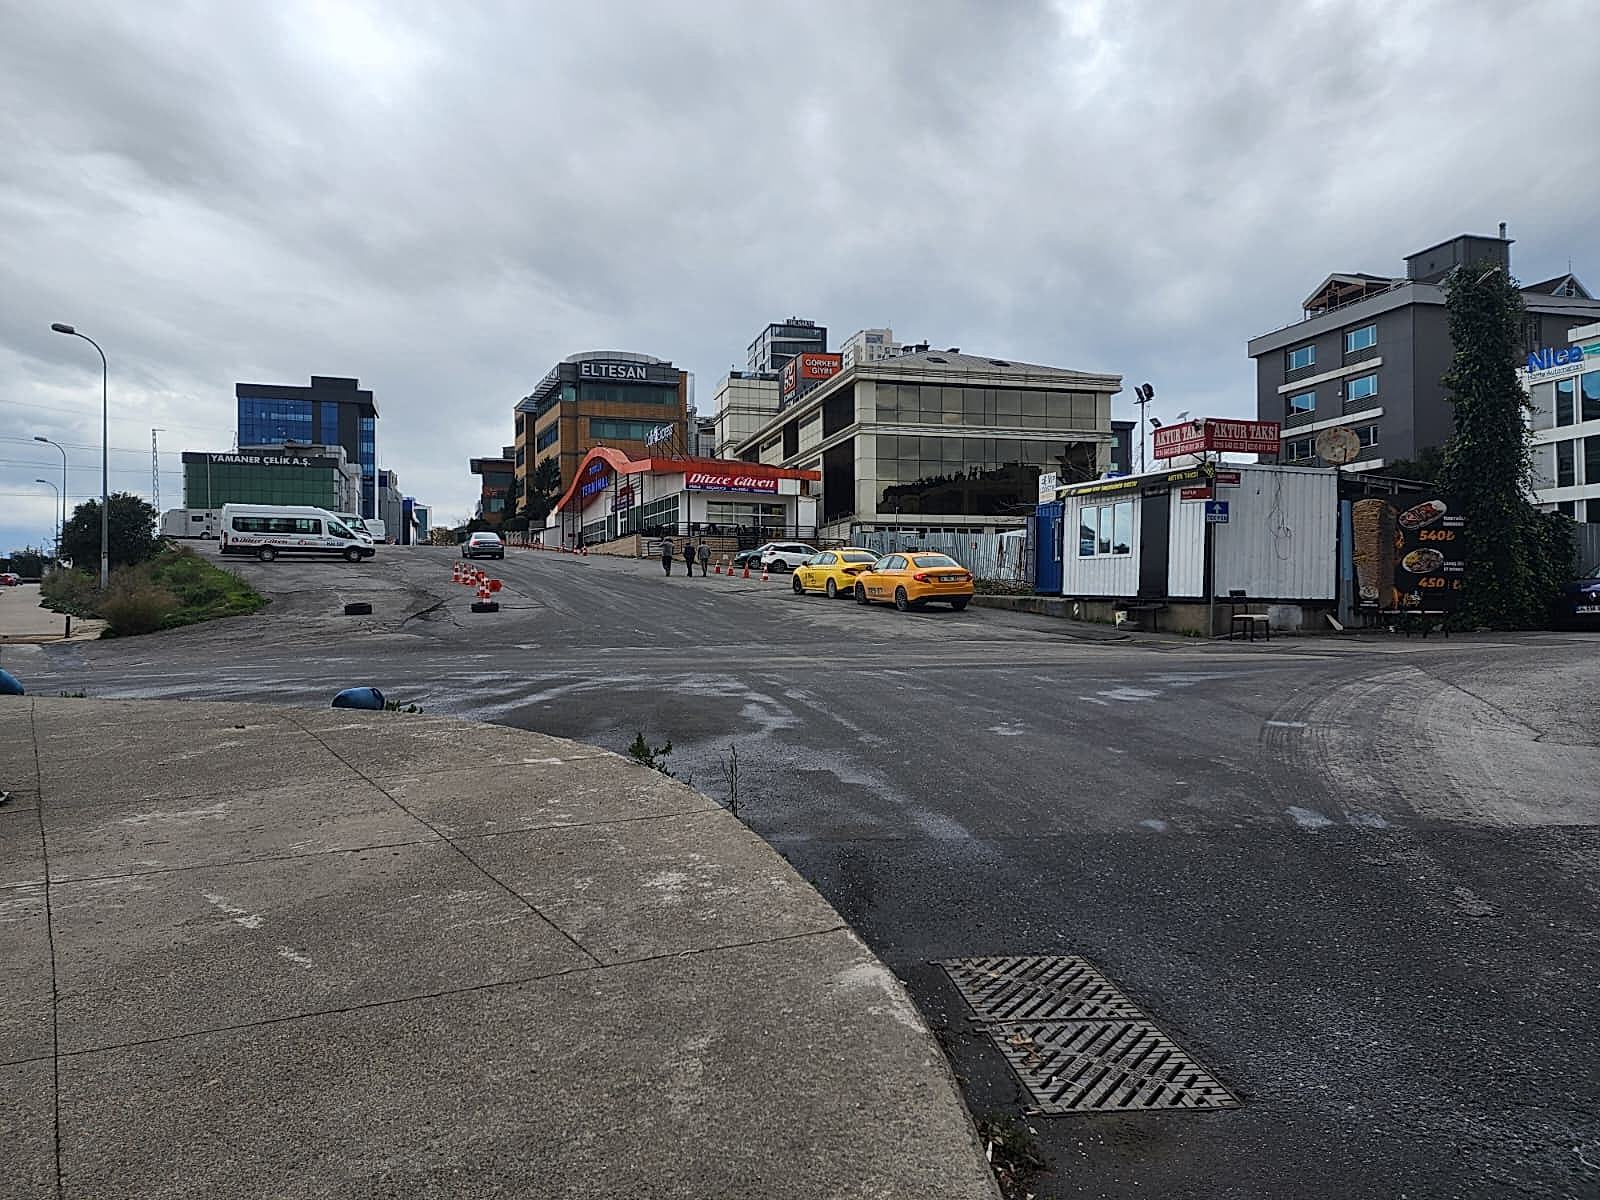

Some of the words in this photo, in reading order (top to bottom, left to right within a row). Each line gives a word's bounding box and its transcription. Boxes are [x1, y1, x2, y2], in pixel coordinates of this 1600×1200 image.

[581, 363, 646, 379] ELTESAN
[1155, 428, 1181, 446] AKTUR
[1214, 423, 1247, 439] AKTUR
[1249, 424, 1278, 440] TAKSİ
[211, 454, 260, 463] YAMANER
[263, 456, 290, 465] ÇELİK
[292, 458, 311, 466] A.Ş.
[690, 473, 730, 484] Düzce
[733, 476, 775, 488] Güven
[1418, 578, 1445, 588] 450
